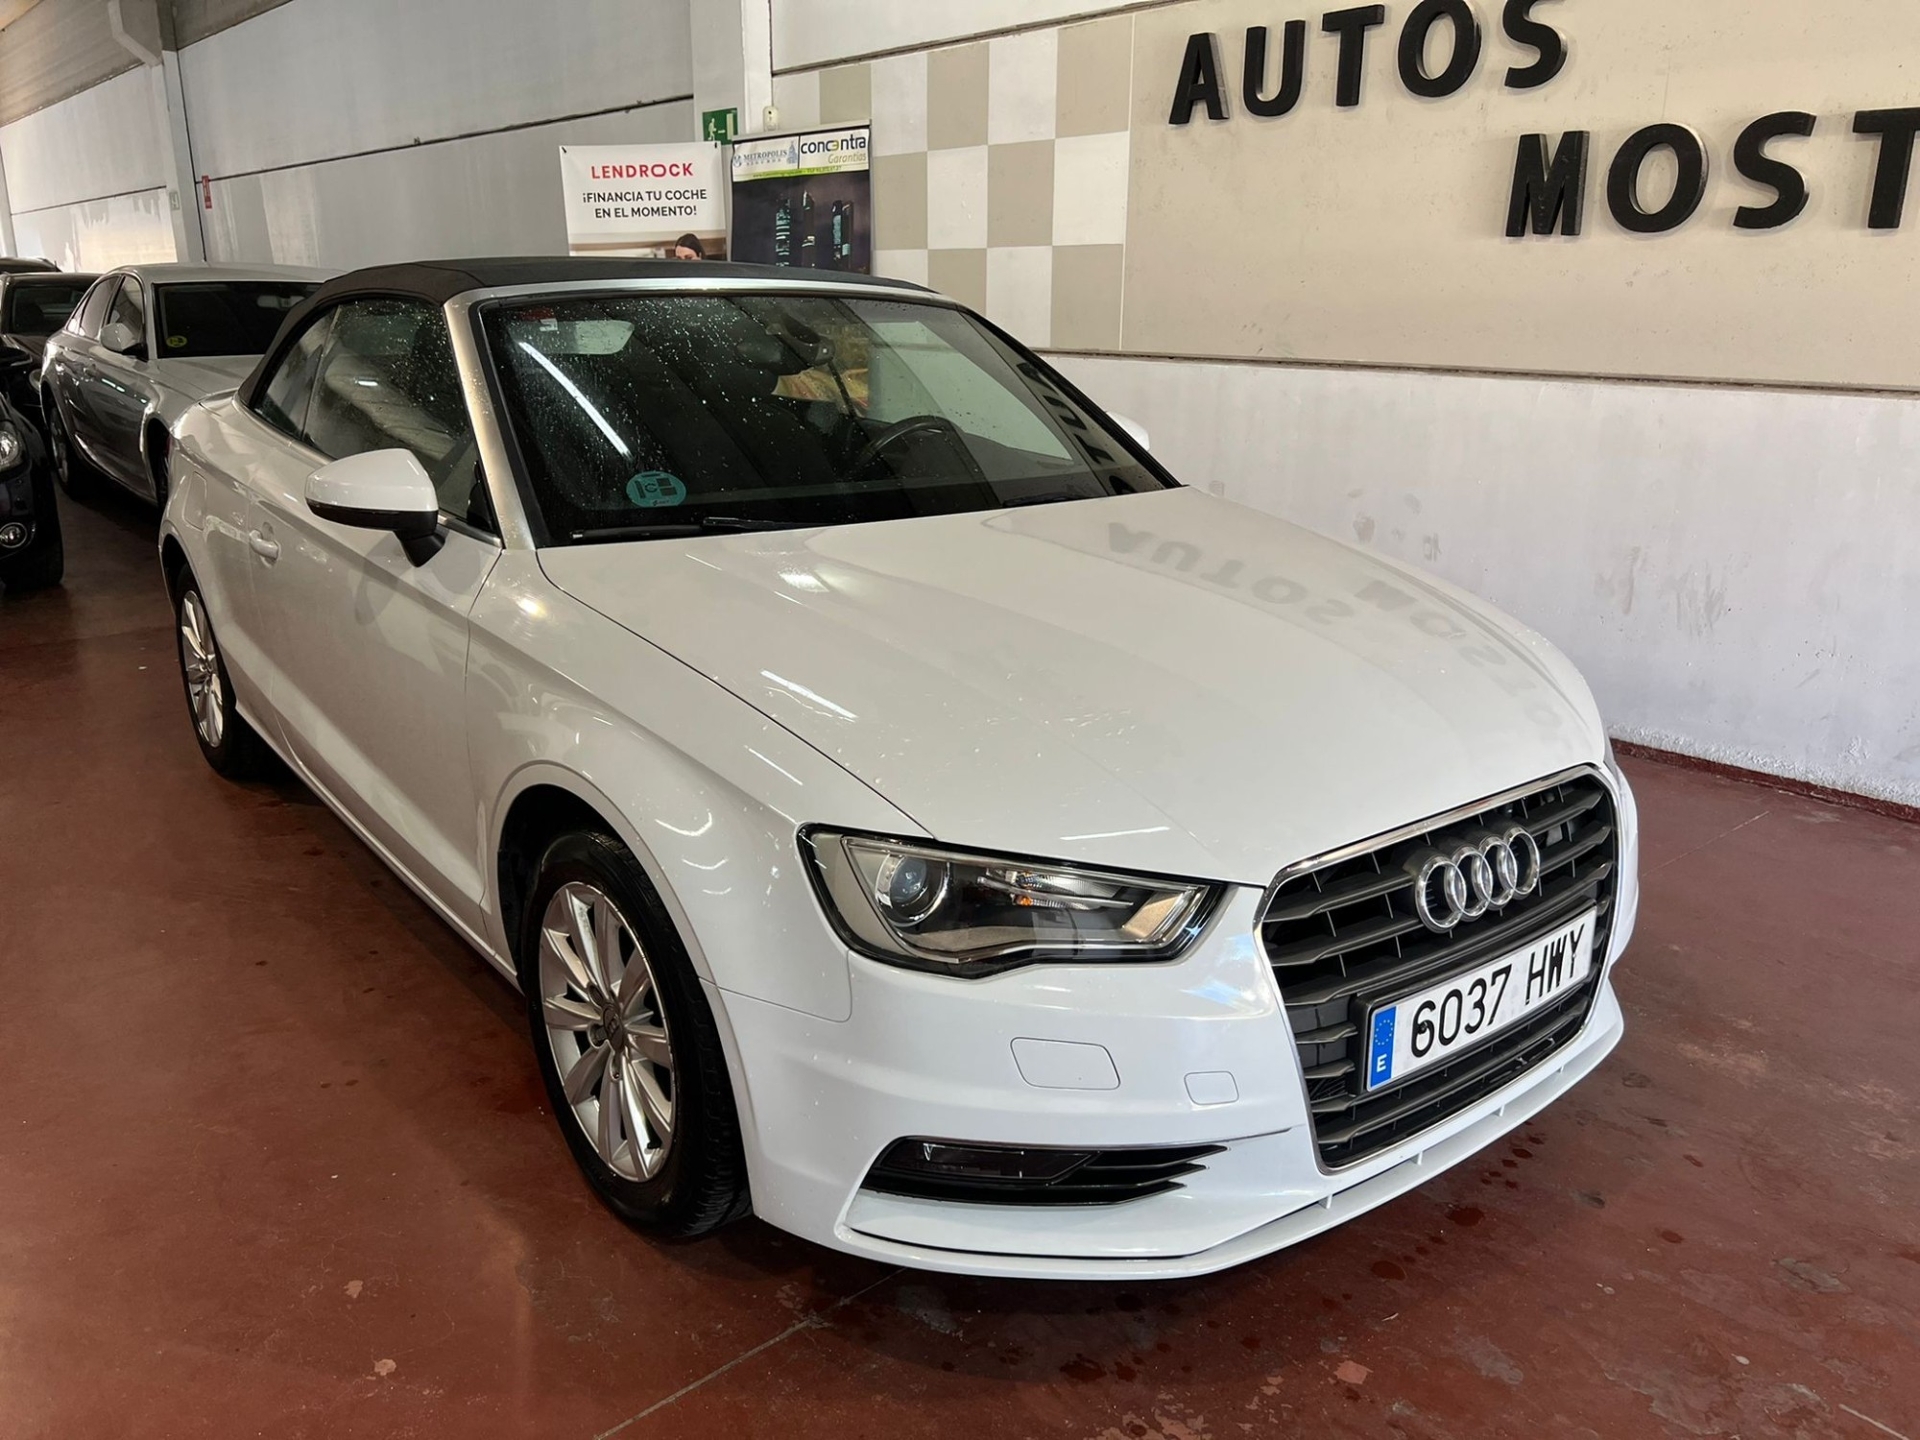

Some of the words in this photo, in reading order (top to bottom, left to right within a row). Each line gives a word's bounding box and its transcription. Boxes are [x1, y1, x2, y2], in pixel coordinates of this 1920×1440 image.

[1168, 0, 1570, 126] AUTOS
[744, 150, 787, 160] METROPOLIS
[591, 162, 694, 179] LENDROCK
[1504, 106, 1920, 238] MOST
[582, 190, 644, 203] ¡FINANCIA
[645, 190, 662, 201] TU
[665, 189, 707, 200] COCHE
[595, 207, 611, 218] EN
[614, 207, 631, 218] EL
[631, 205, 697, 218] MOMENTO!
[1410, 963, 1513, 1059] 6037
[1524, 923, 1586, 1006] HWY
[1376, 1054, 1387, 1073] E
